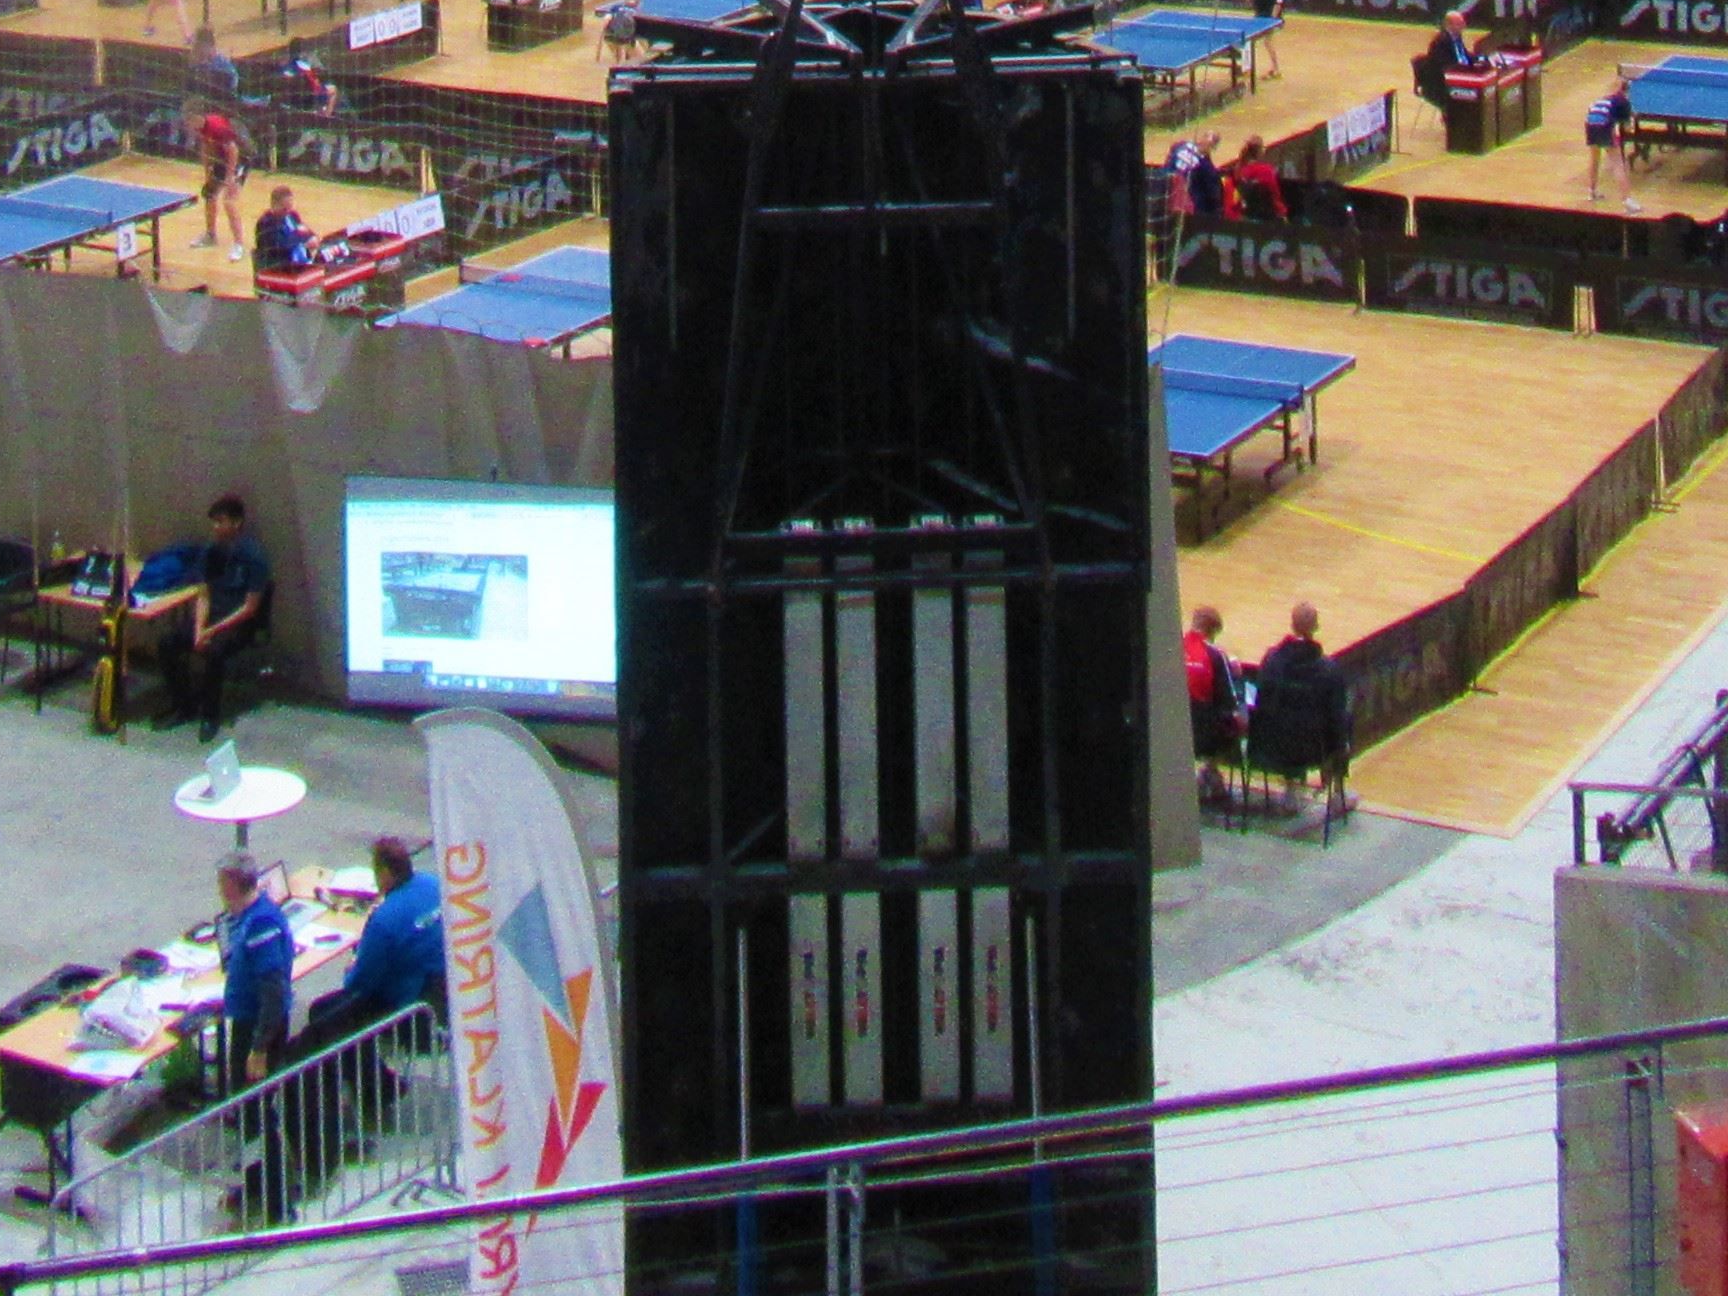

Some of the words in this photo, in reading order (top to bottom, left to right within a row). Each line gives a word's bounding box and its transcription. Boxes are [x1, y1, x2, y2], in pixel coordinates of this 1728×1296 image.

[5, 112, 122, 174] STIGA
[287, 130, 417, 178] STIGA
[466, 169, 573, 240] STIGA
[121, 232, 133, 251] 3
[1177, 233, 1344, 289] STIGA
[1393, 260, 1546, 310] STIGA
